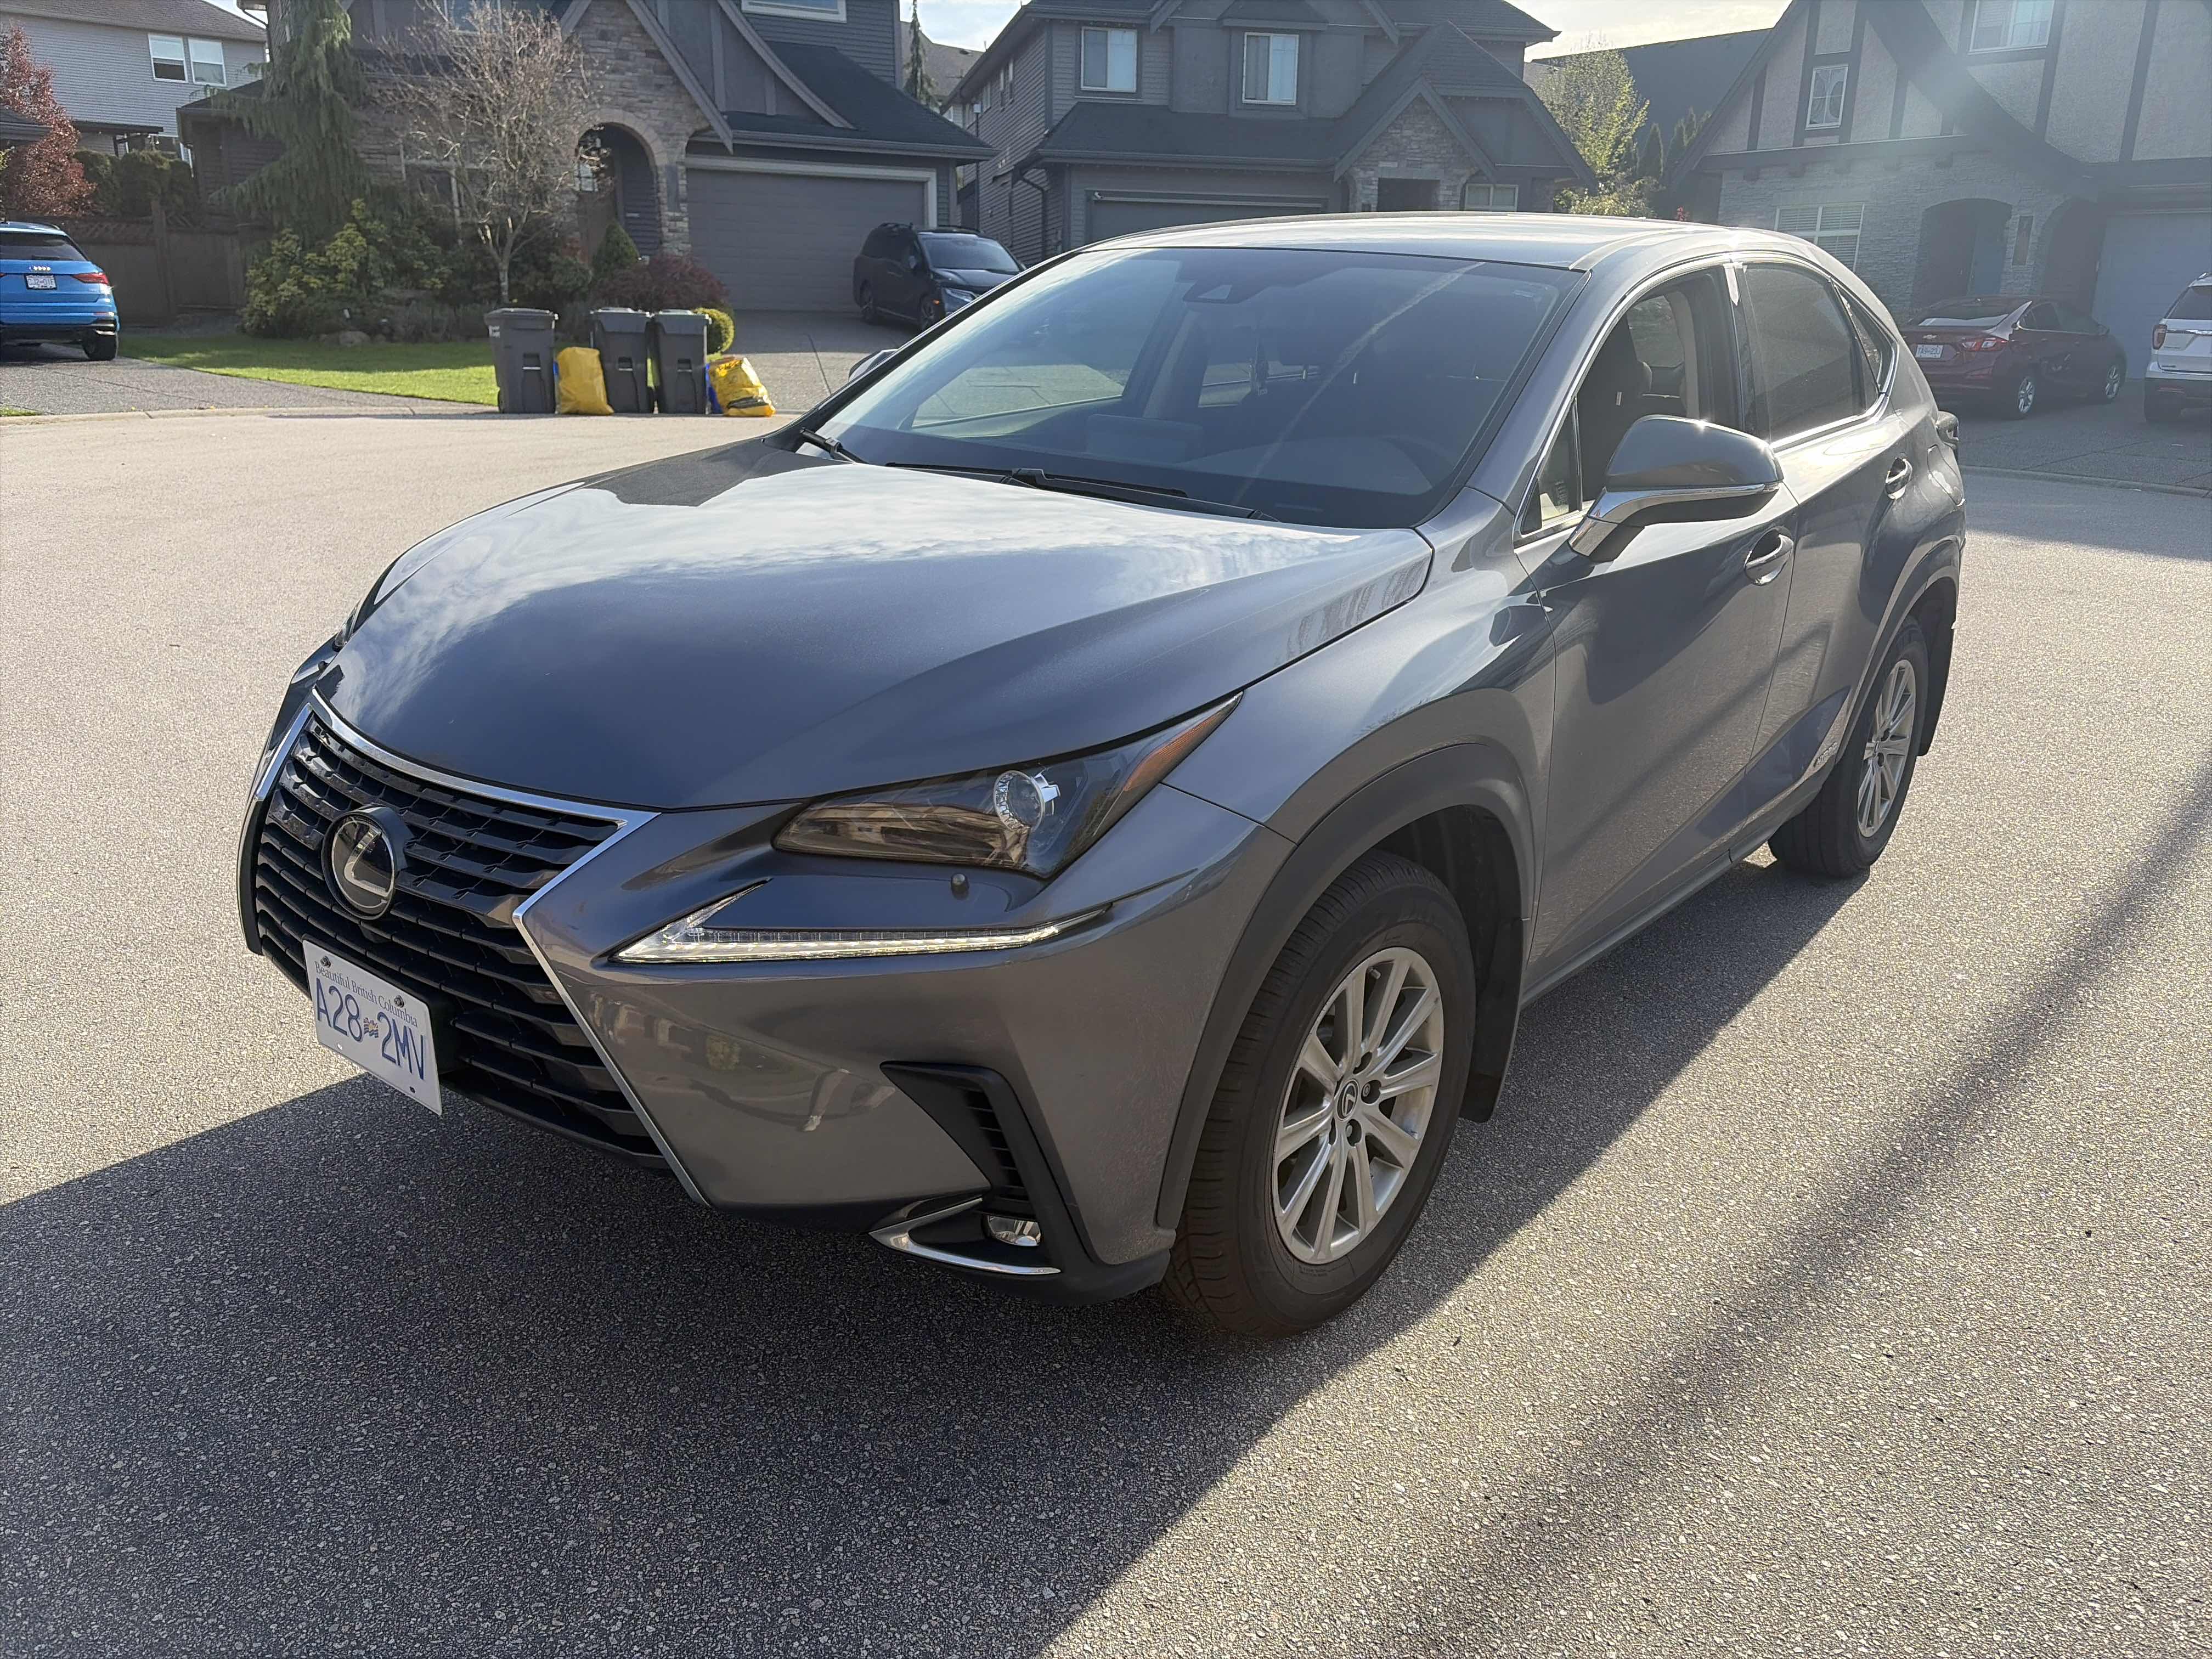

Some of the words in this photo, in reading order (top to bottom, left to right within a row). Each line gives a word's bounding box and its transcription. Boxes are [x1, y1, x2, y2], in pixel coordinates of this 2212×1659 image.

[314, 961, 350, 990] Beautiful
[352, 980, 377, 1005] British
[378, 996, 417, 1028] Columbia
[316, 977, 363, 1043] A28
[377, 1011, 424, 1080] 2MV
